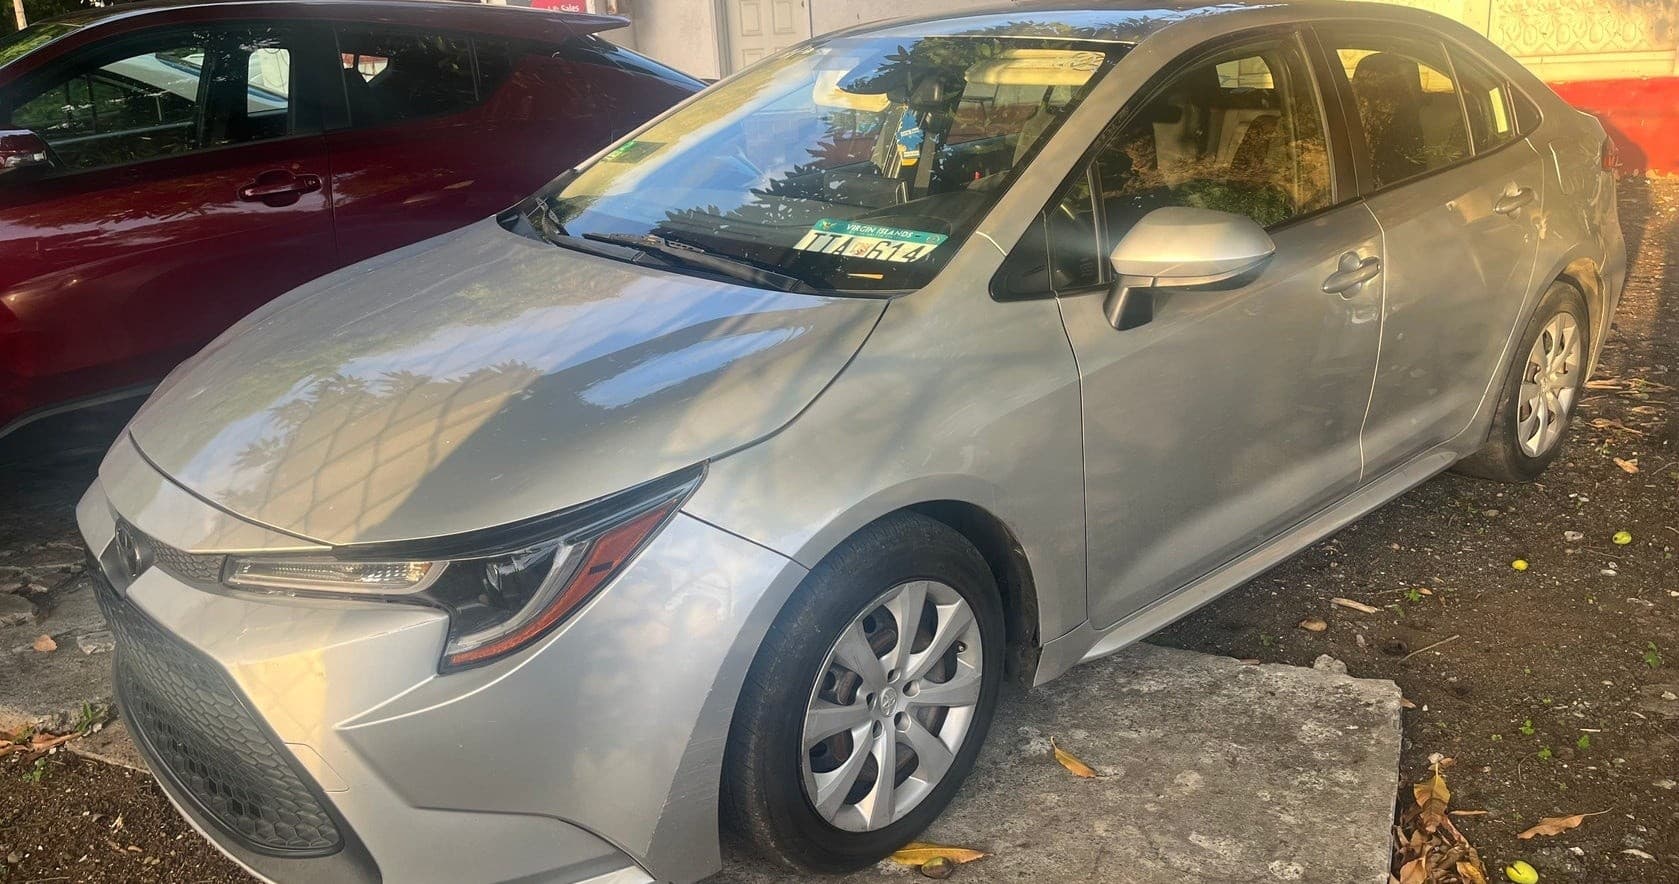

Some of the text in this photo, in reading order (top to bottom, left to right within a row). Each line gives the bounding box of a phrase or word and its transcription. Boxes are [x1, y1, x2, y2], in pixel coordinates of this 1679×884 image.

[846, 223, 875, 233] VIRGIN
[876, 226, 914, 238] ISLANDS
[865, 240, 925, 263] 614
